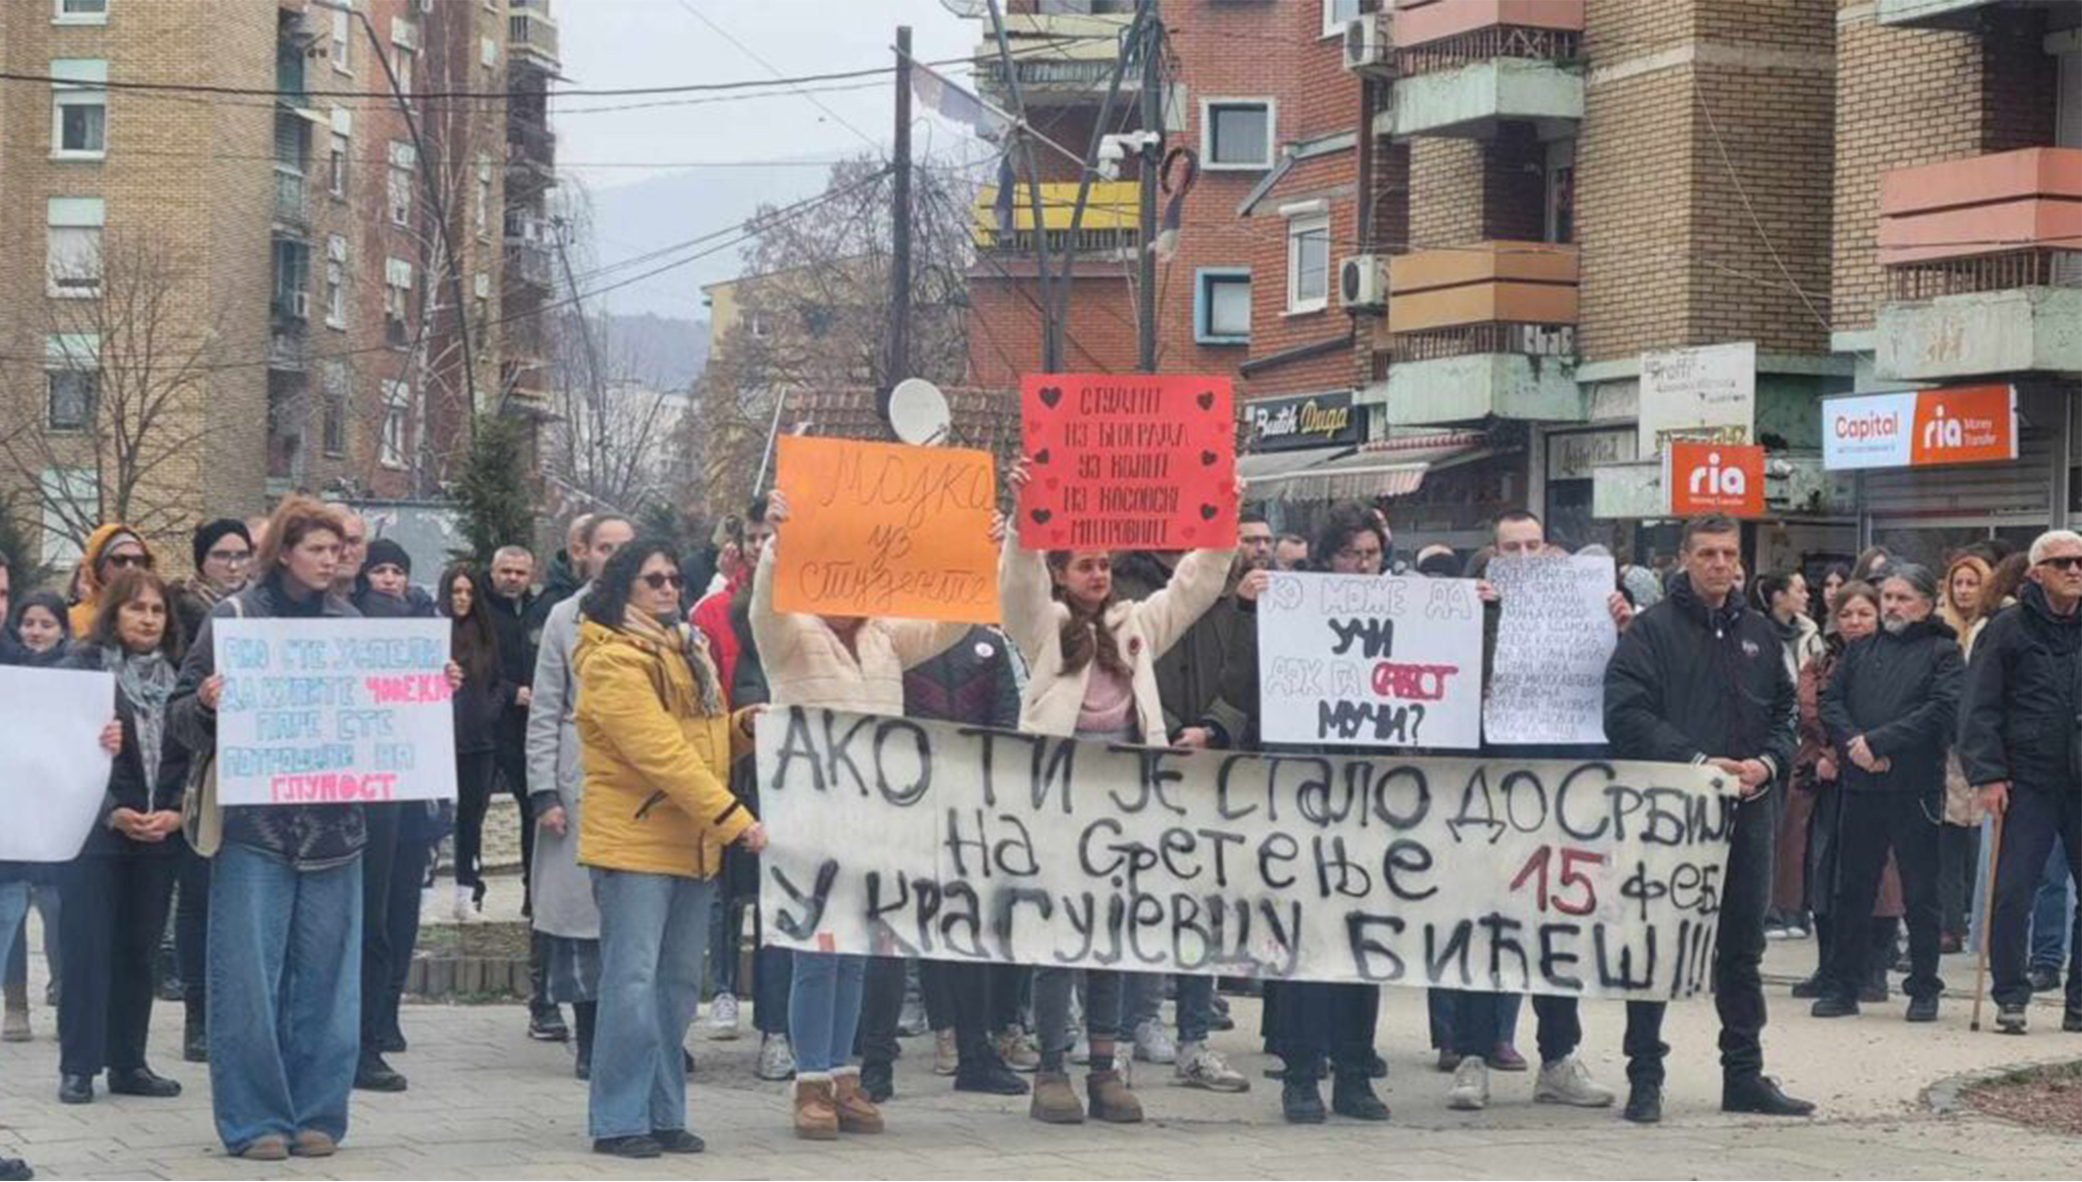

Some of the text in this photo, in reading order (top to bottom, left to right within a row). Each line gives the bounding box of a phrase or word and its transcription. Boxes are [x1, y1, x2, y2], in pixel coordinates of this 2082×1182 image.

[1300, 398, 1348, 441] Duga
[1835, 411, 1898, 442] Capital
[1923, 404, 1963, 449] ria
[1078, 454, 1100, 479] УЗ
[1689, 451, 1746, 495] ria
[1064, 486, 1087, 513] ИЗ
[1320, 578, 1406, 616] МОЖЕ
[1426, 581, 1472, 620] ДА
[281, 639, 327, 669] СТЕ
[1328, 617, 1394, 658] УЧИ
[1330, 660, 1361, 697] ГА
[336, 709, 393, 739] СТЕ
[1318, 700, 1425, 746] МУЧИ?
[374, 743, 415, 772] НА
[772, 705, 931, 806] АКО
[957, 727, 1077, 813] ТИ
[1107, 743, 1192, 814] ЈЕ
[771, 859, 839, 939] У
[1509, 845, 1602, 916] 15
